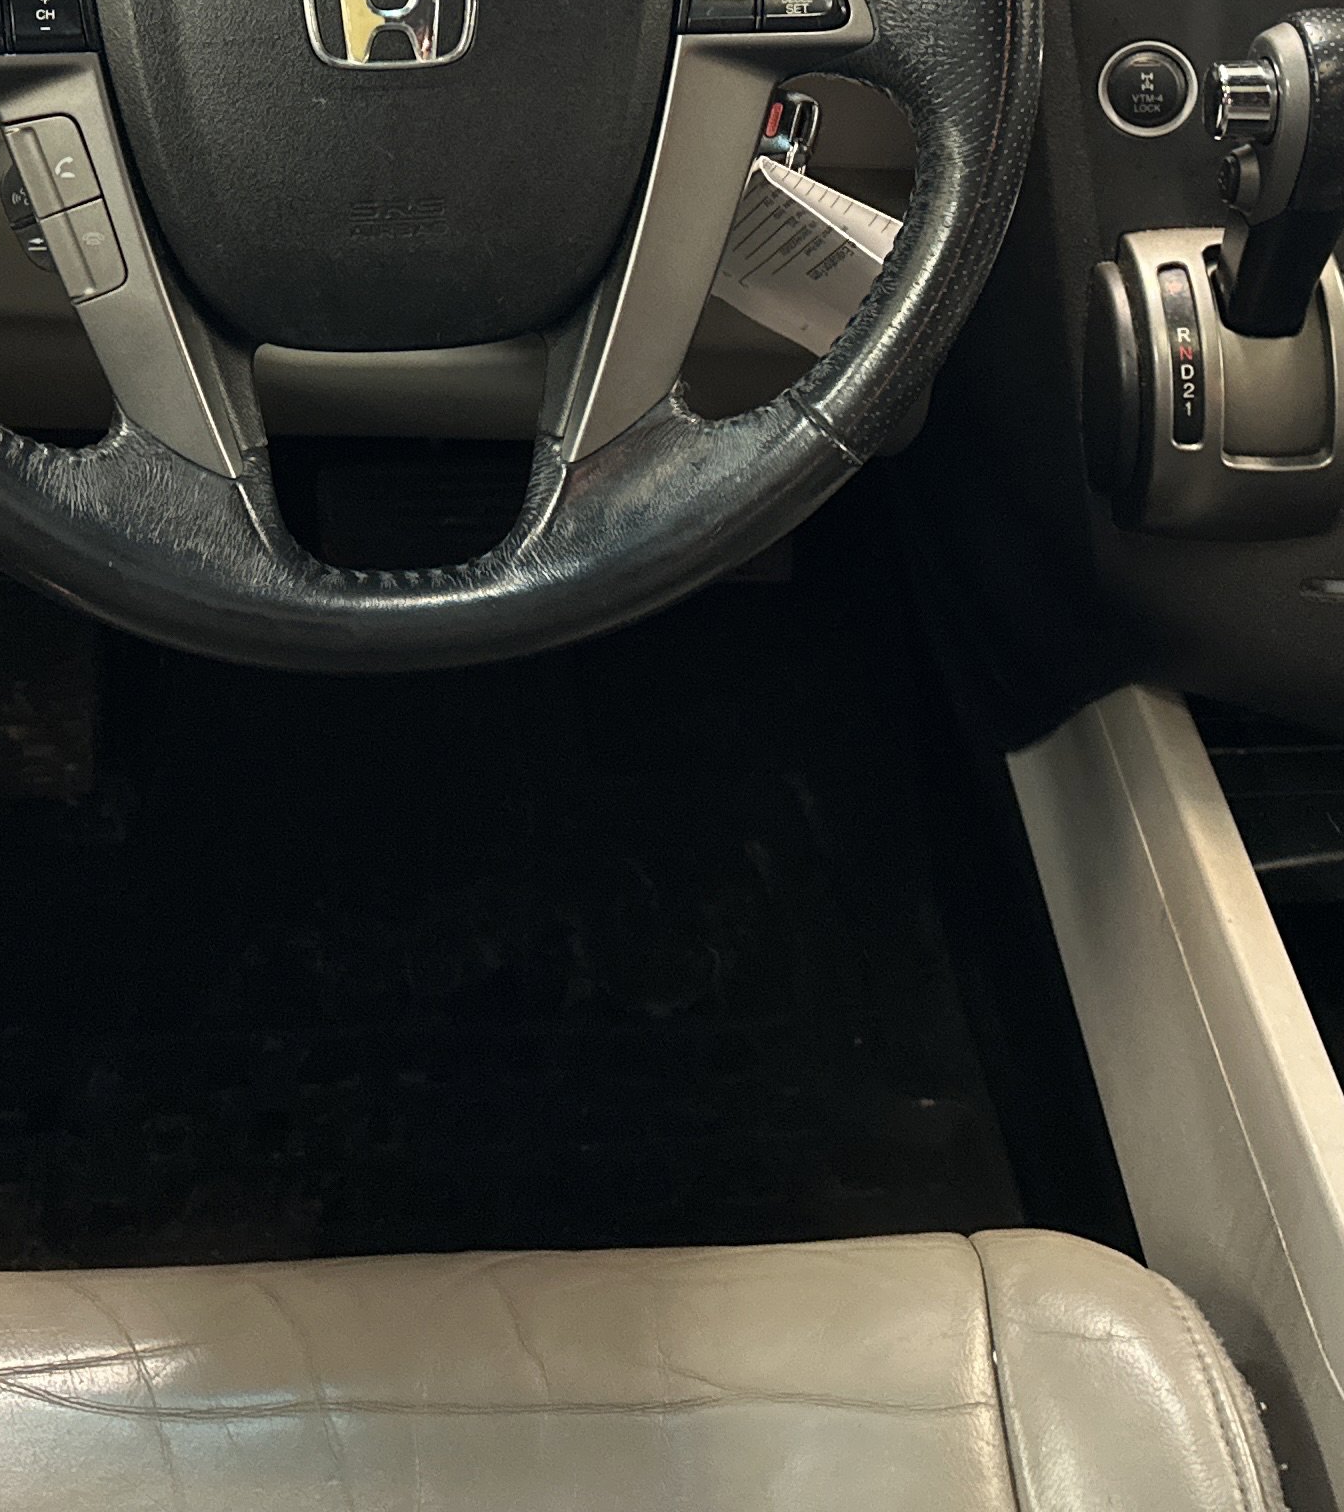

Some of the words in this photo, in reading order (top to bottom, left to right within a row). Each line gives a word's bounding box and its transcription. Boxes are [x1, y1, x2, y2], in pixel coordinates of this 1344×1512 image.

[35, 9, 55, 20] CH
[785, 4, 809, 14] SET
[1131, 93, 1164, 103] VTM-4
[1134, 103, 1161, 113] LOCK
[1176, 327, 1190, 343] R
[1179, 346, 1193, 361] N
[1180, 364, 1195, 380] D
[1183, 383, 1195, 398] 2
[1185, 401, 1192, 416] 1
